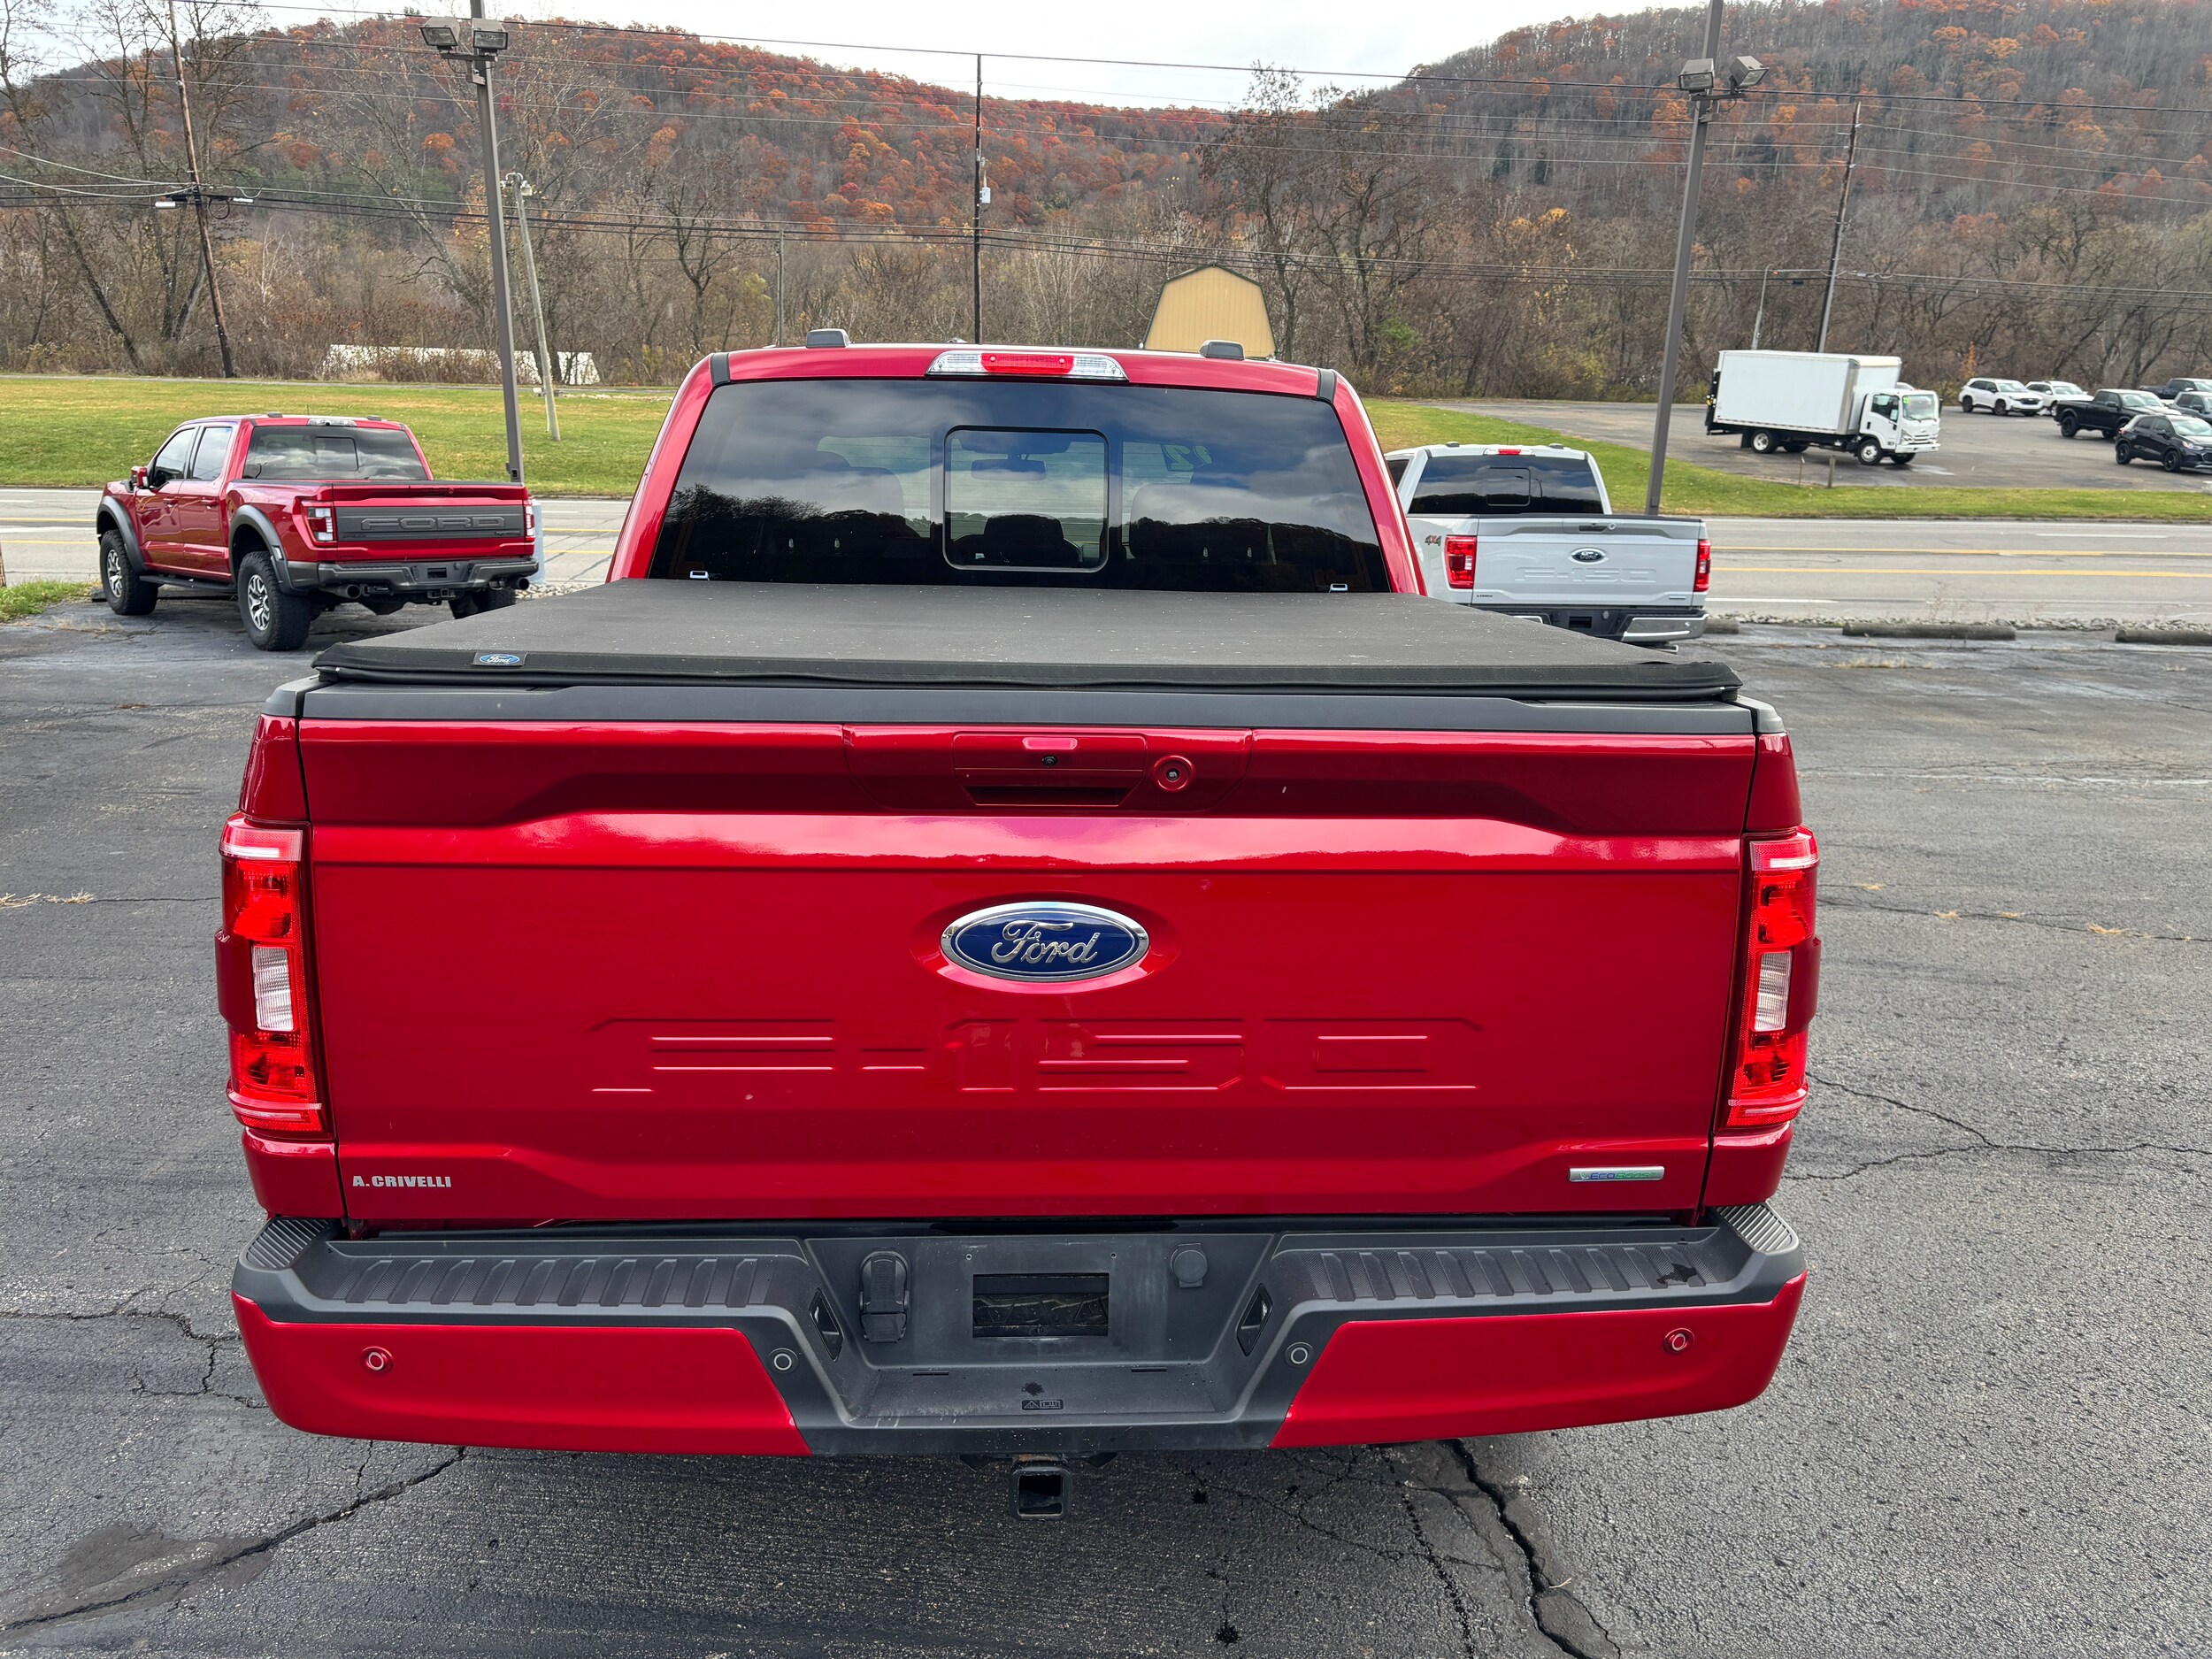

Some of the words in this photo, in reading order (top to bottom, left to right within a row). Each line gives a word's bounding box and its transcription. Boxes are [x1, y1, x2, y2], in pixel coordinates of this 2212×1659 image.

[361, 517, 506, 530] FORD
[487, 655, 512, 664] Ford
[991, 919, 1102, 964] Ford
[588, 1018, 1481, 1092] F-150
